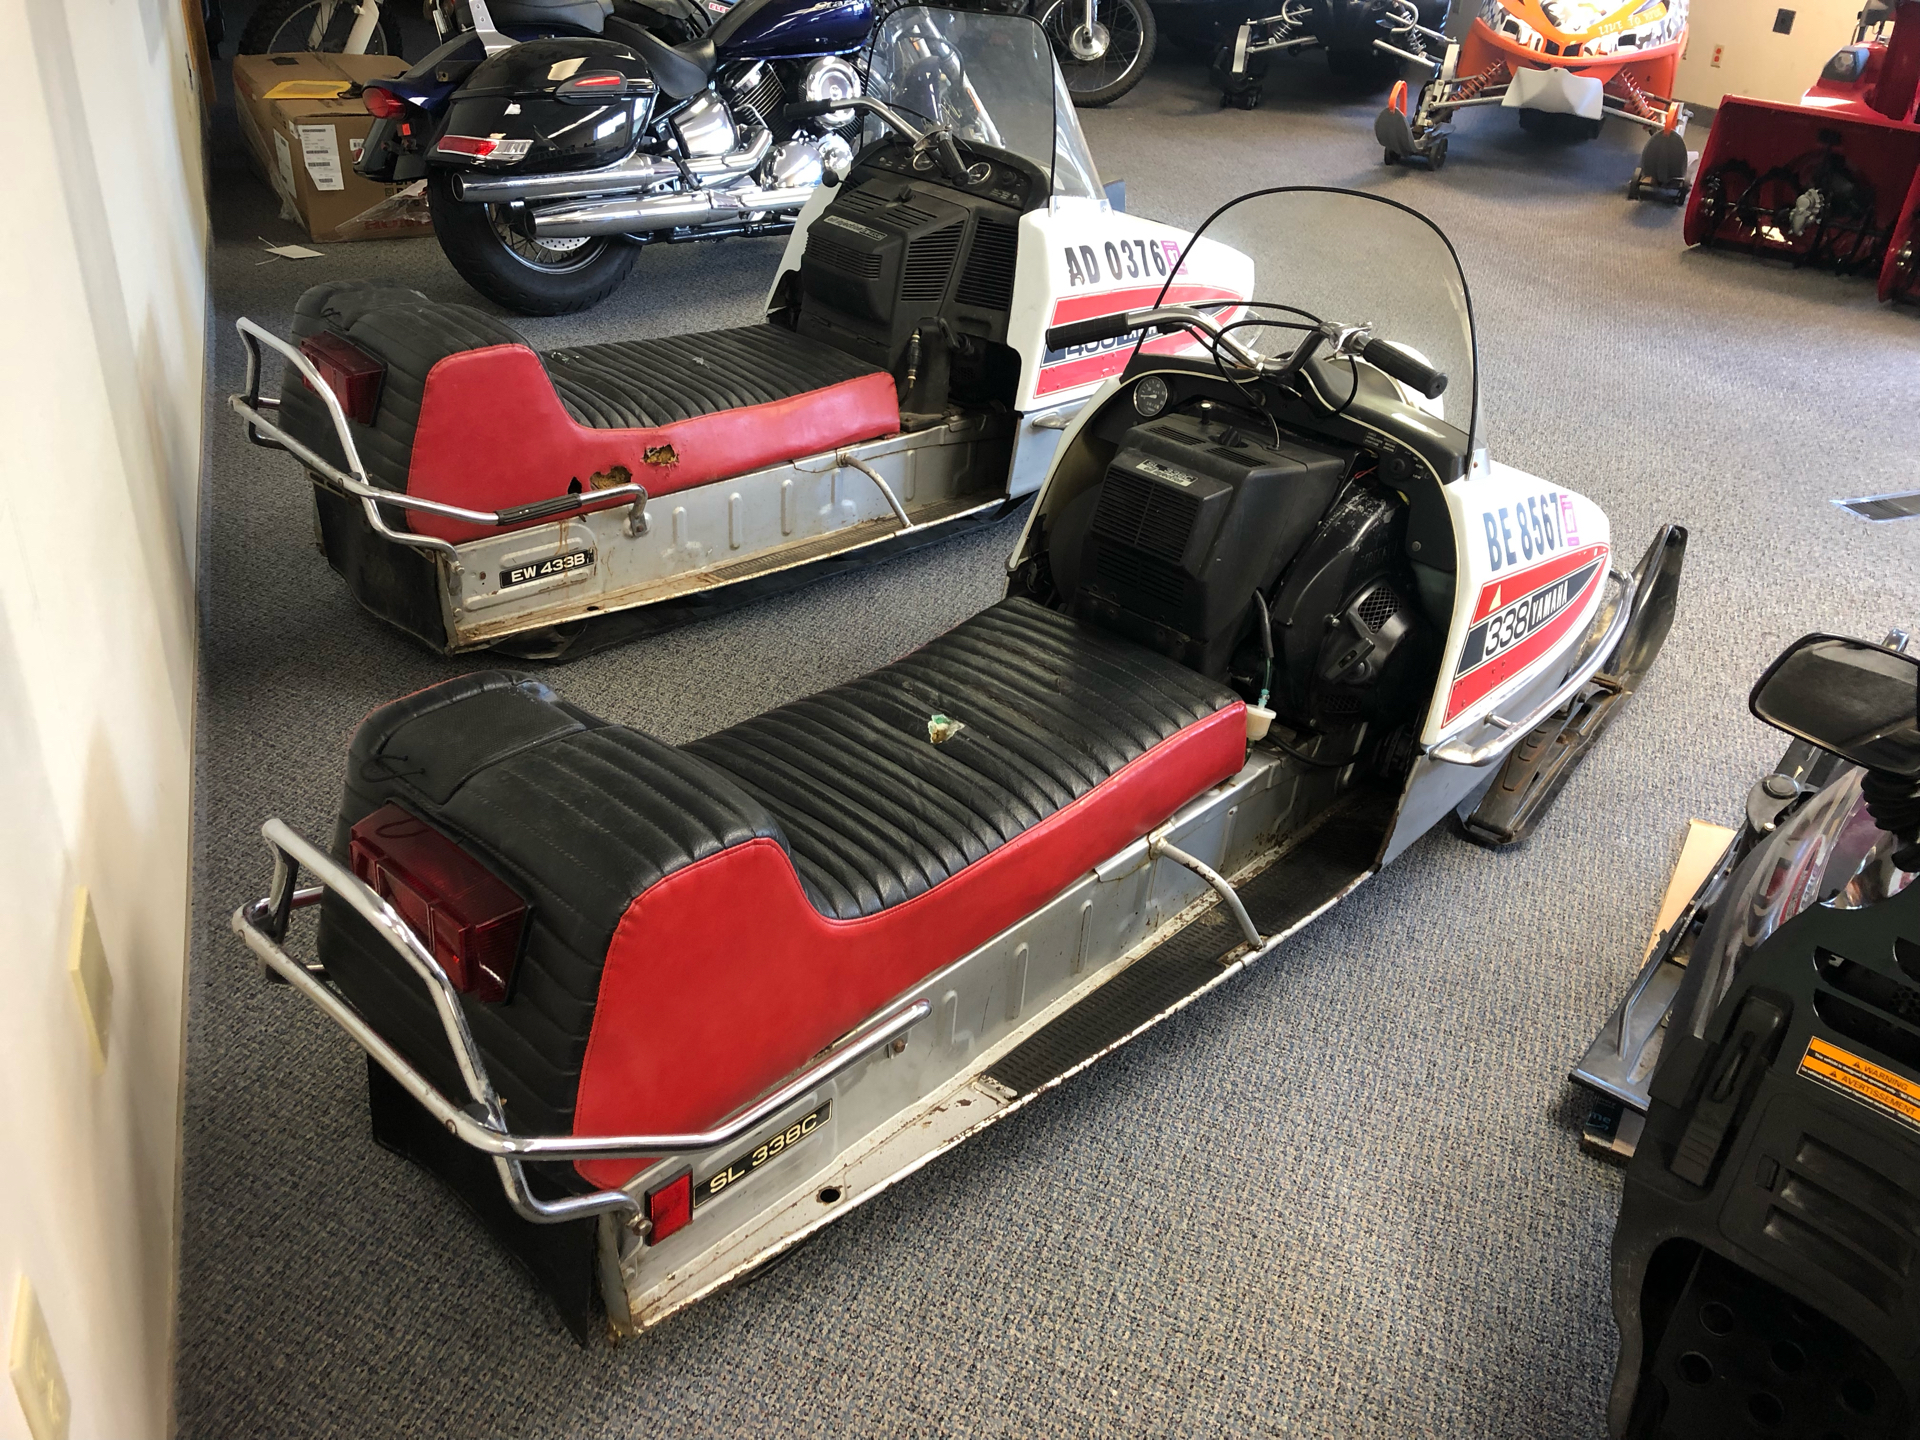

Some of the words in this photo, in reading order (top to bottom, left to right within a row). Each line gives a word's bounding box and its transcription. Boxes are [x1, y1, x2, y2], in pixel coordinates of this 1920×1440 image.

[1064, 245, 1100, 287] AD
[1104, 239, 1166, 281] 0376
[1482, 507, 1517, 572] BE
[1516, 492, 1563, 561] 8567
[511, 565, 537, 582] EW
[540, 553, 585, 574] 433B
[1485, 600, 1529, 656] 338
[1532, 580, 1568, 625] YAMAHA
[1841, 1075, 1917, 1115] AVERTISSEMENT
[1864, 1065, 1909, 1091] WARNING
[710, 1167, 745, 1193] SL
[752, 1113, 817, 1166] 338C
